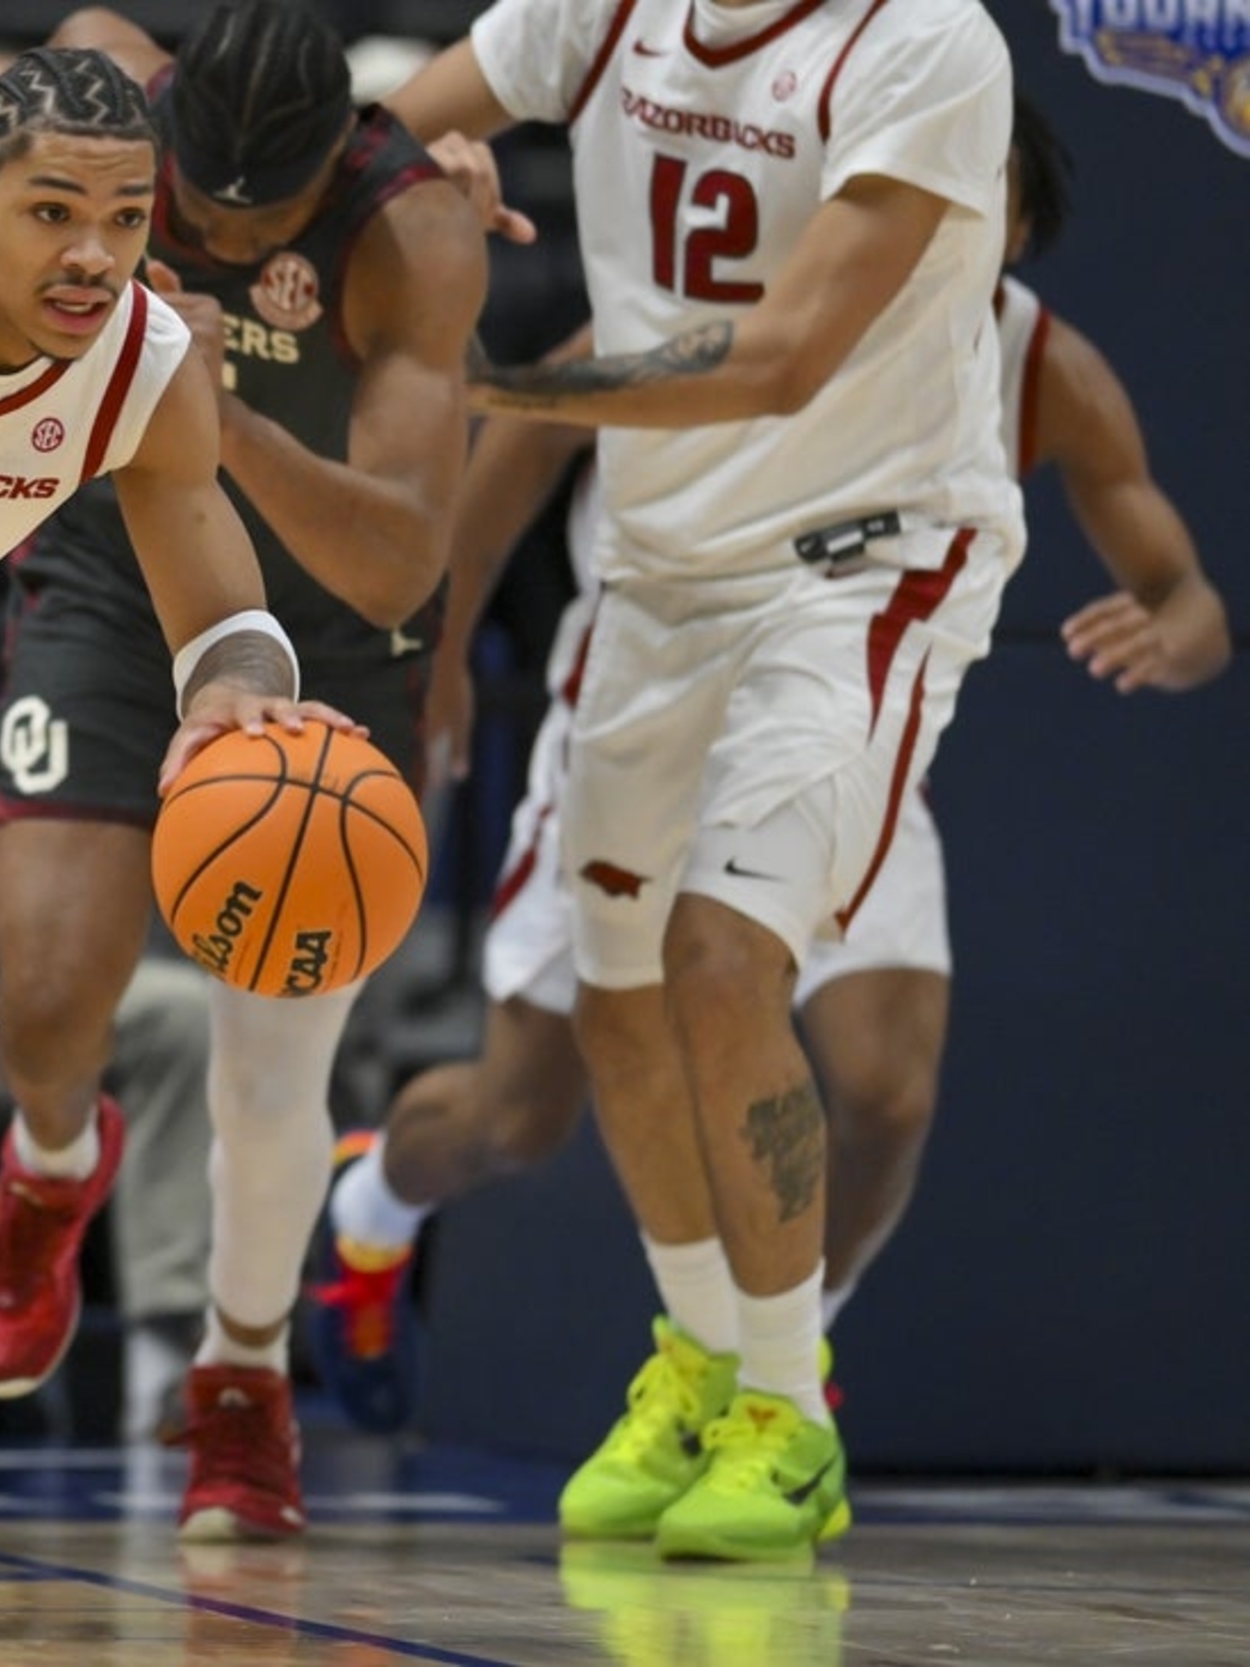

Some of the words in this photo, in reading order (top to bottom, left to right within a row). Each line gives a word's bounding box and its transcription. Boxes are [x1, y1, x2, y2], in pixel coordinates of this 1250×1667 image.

[648, 151, 765, 304] 12
[33, 420, 63, 450] SEC
[0, 696, 68, 793] OU
[280, 930, 332, 997] CAA
